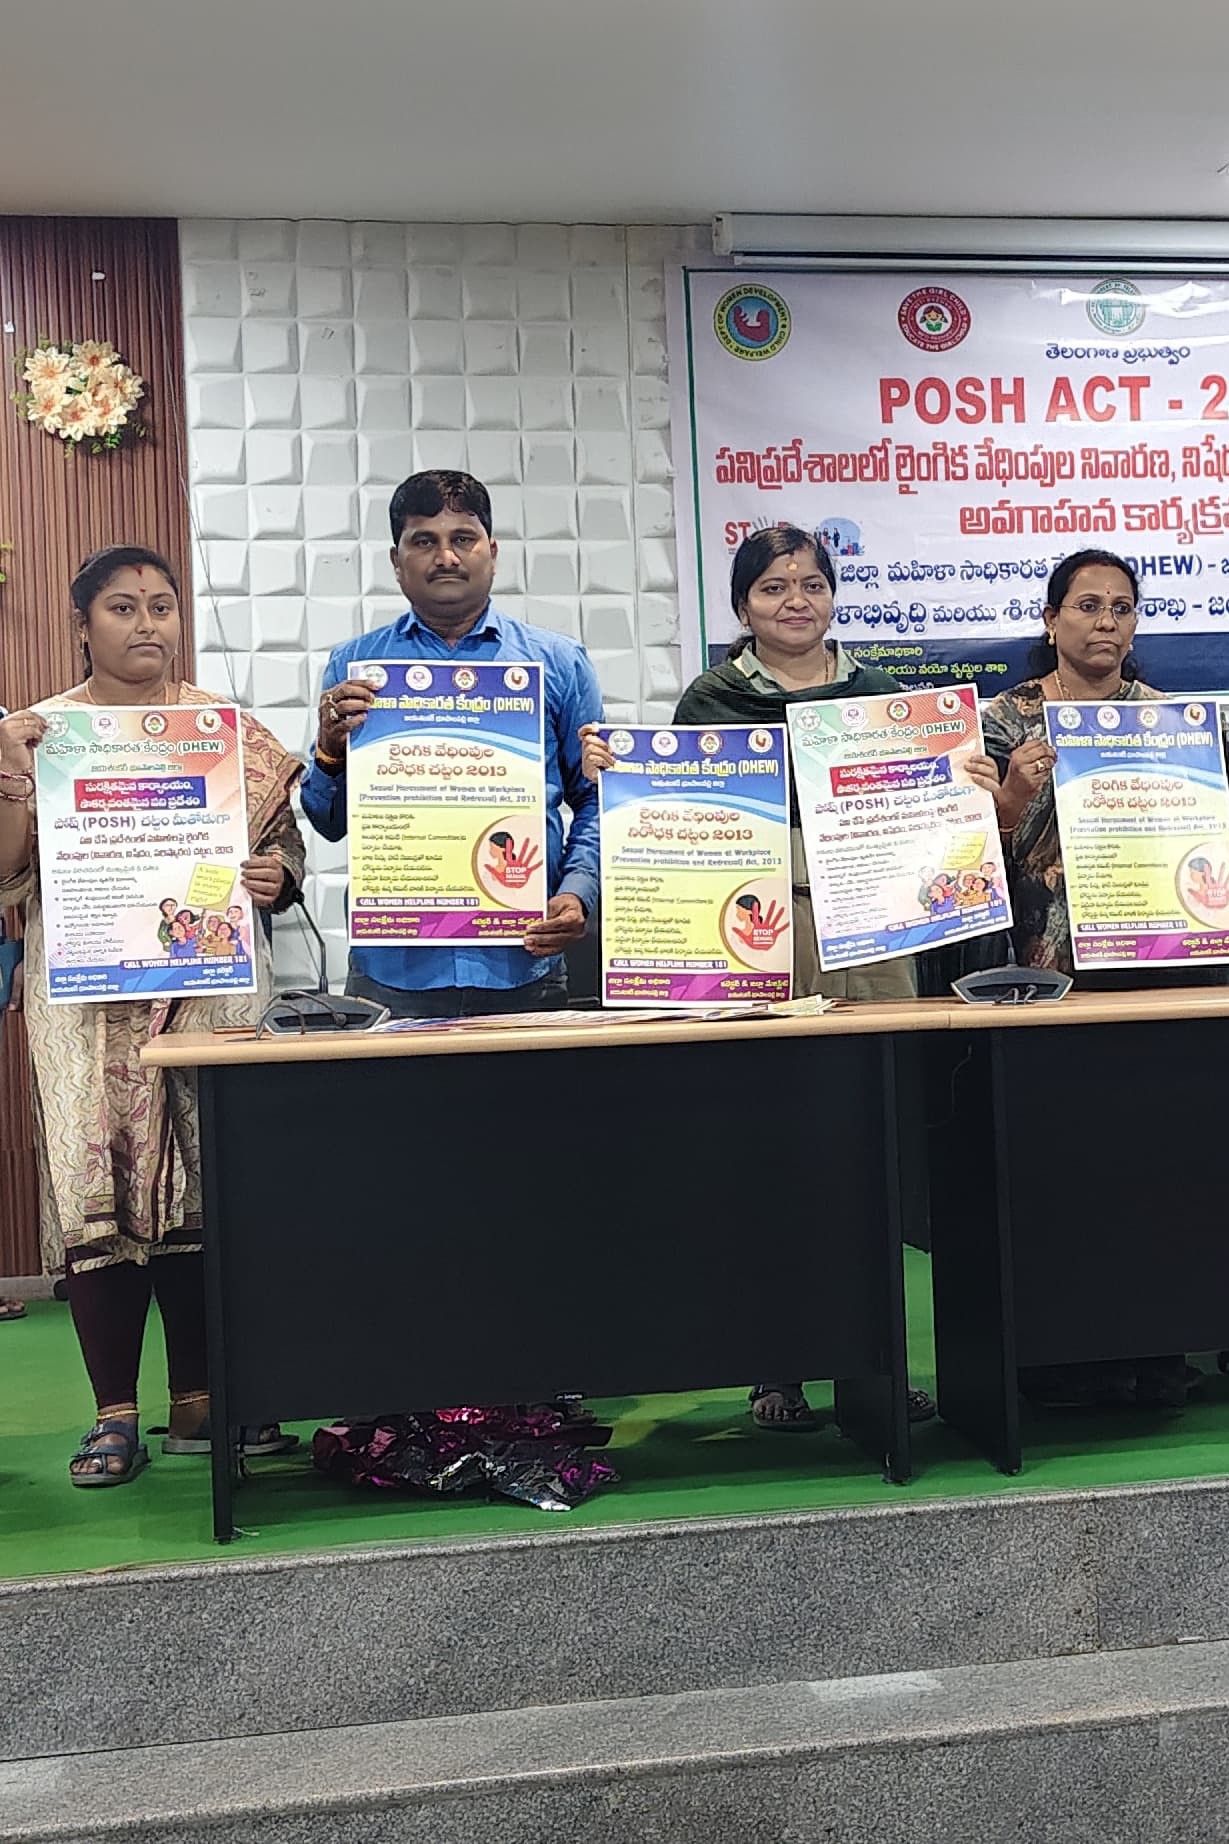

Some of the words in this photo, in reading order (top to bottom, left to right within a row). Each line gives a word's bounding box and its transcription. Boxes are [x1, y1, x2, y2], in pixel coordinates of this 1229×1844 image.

[1046, 342, 1119, 359] తెలంగాణ
[1123, 345, 1191, 365] ప్రభుత్వం
[880, 377, 1026, 424] POSH
[1045, 375, 1151, 422] ACT
[1168, 399, 1184, 409] -
[715, 437, 890, 491] పనిప్రదేశాలలో
[895, 440, 969, 495] లైంగిక
[975, 437, 1075, 488] వేధింపుల
[960, 497, 1117, 535] అవగాహన
[840, 562, 880, 590] జిల్లా
[887, 560, 956, 583] మహిళా
[959, 558, 1049, 583] సాధికారత
[1123, 553, 1203, 578] DHEW)
[933, 604, 997, 623] మరియు
[880, 664, 917, 676] రియు
[493, 696, 535, 714] (DHEW)
[920, 721, 966, 737] (DHEW)
[177, 739, 225, 755] (DHEW)
[1176, 731, 1214, 748] (DHEW)
[466, 764, 508, 777] 2013
[738, 759, 779, 778] (DHEW)
[841, 798, 890, 814] (POSH)
[82, 815, 136, 831] (POSH)
[712, 828, 754, 841] 2013
[506, 866, 527, 874] STOP
[466, 898, 479, 906] 181
